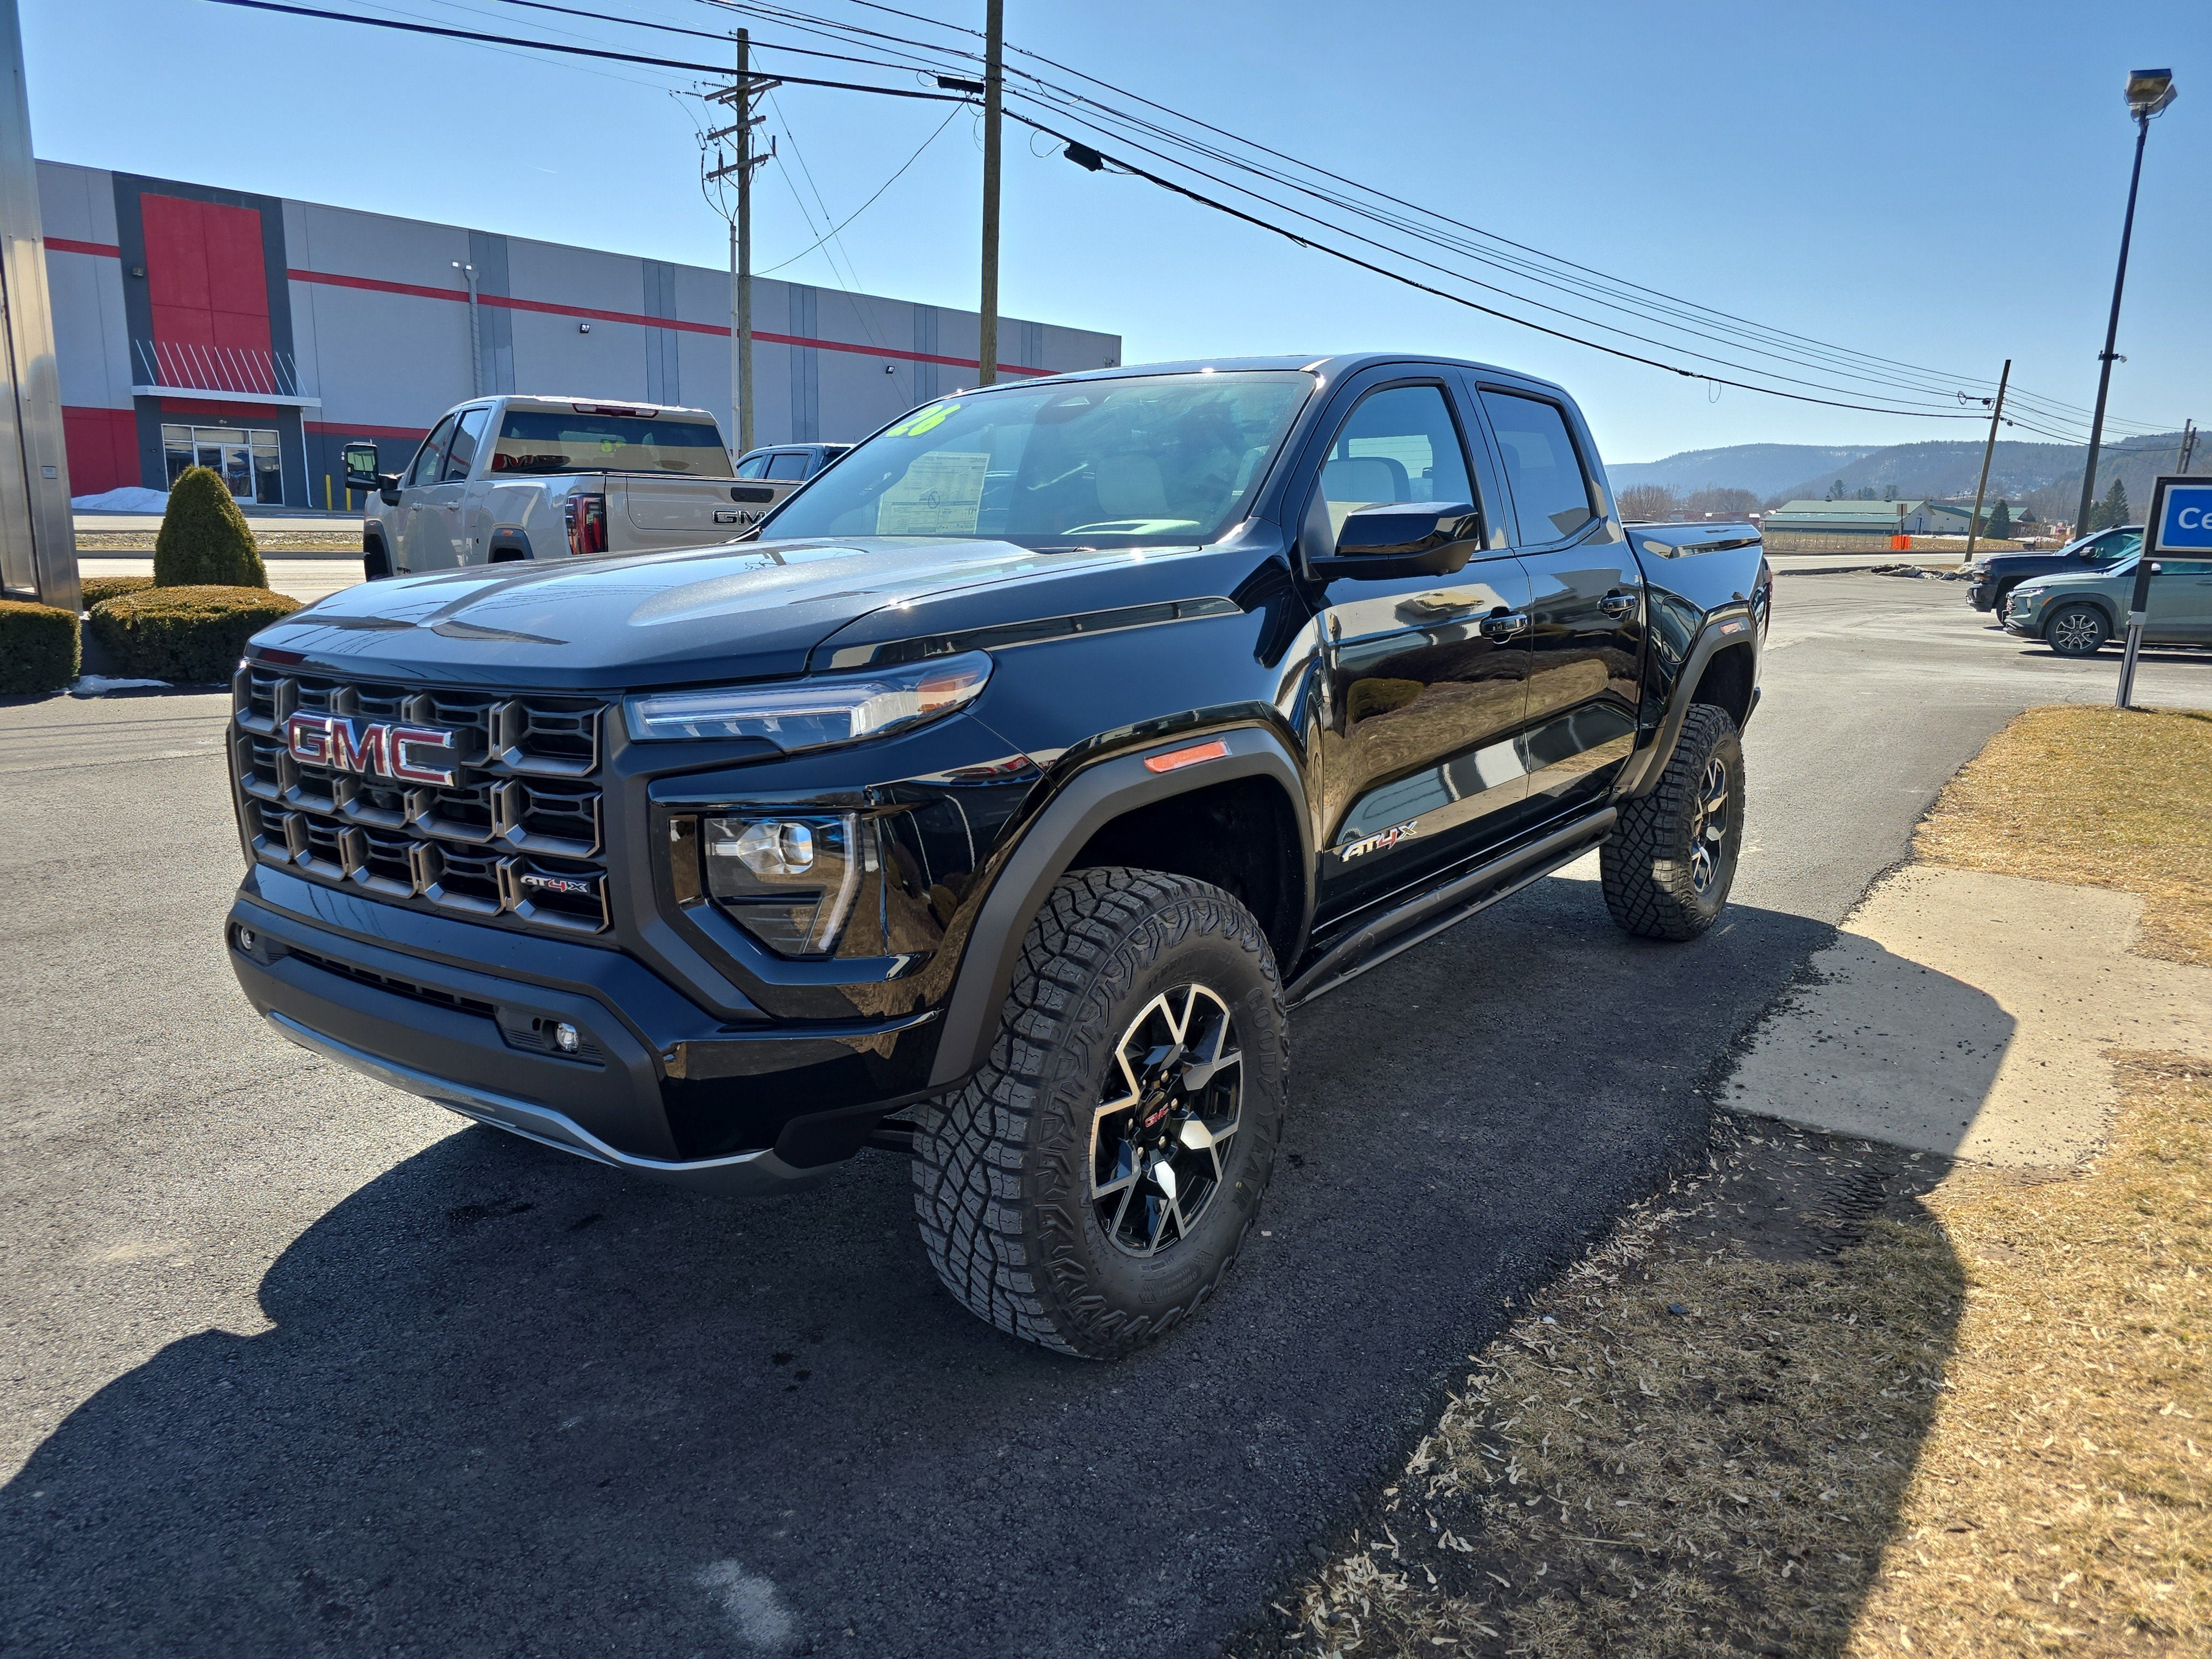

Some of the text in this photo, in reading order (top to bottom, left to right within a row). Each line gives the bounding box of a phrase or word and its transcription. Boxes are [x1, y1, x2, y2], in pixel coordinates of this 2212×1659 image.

[885, 404, 961, 437] 26
[2178, 507, 2212, 529] Ce
[288, 711, 454, 786] GMC
[1339, 820, 1417, 863] AT4X
[520, 874, 588, 892] AT4X
[1144, 1102, 1169, 1128] GMC
